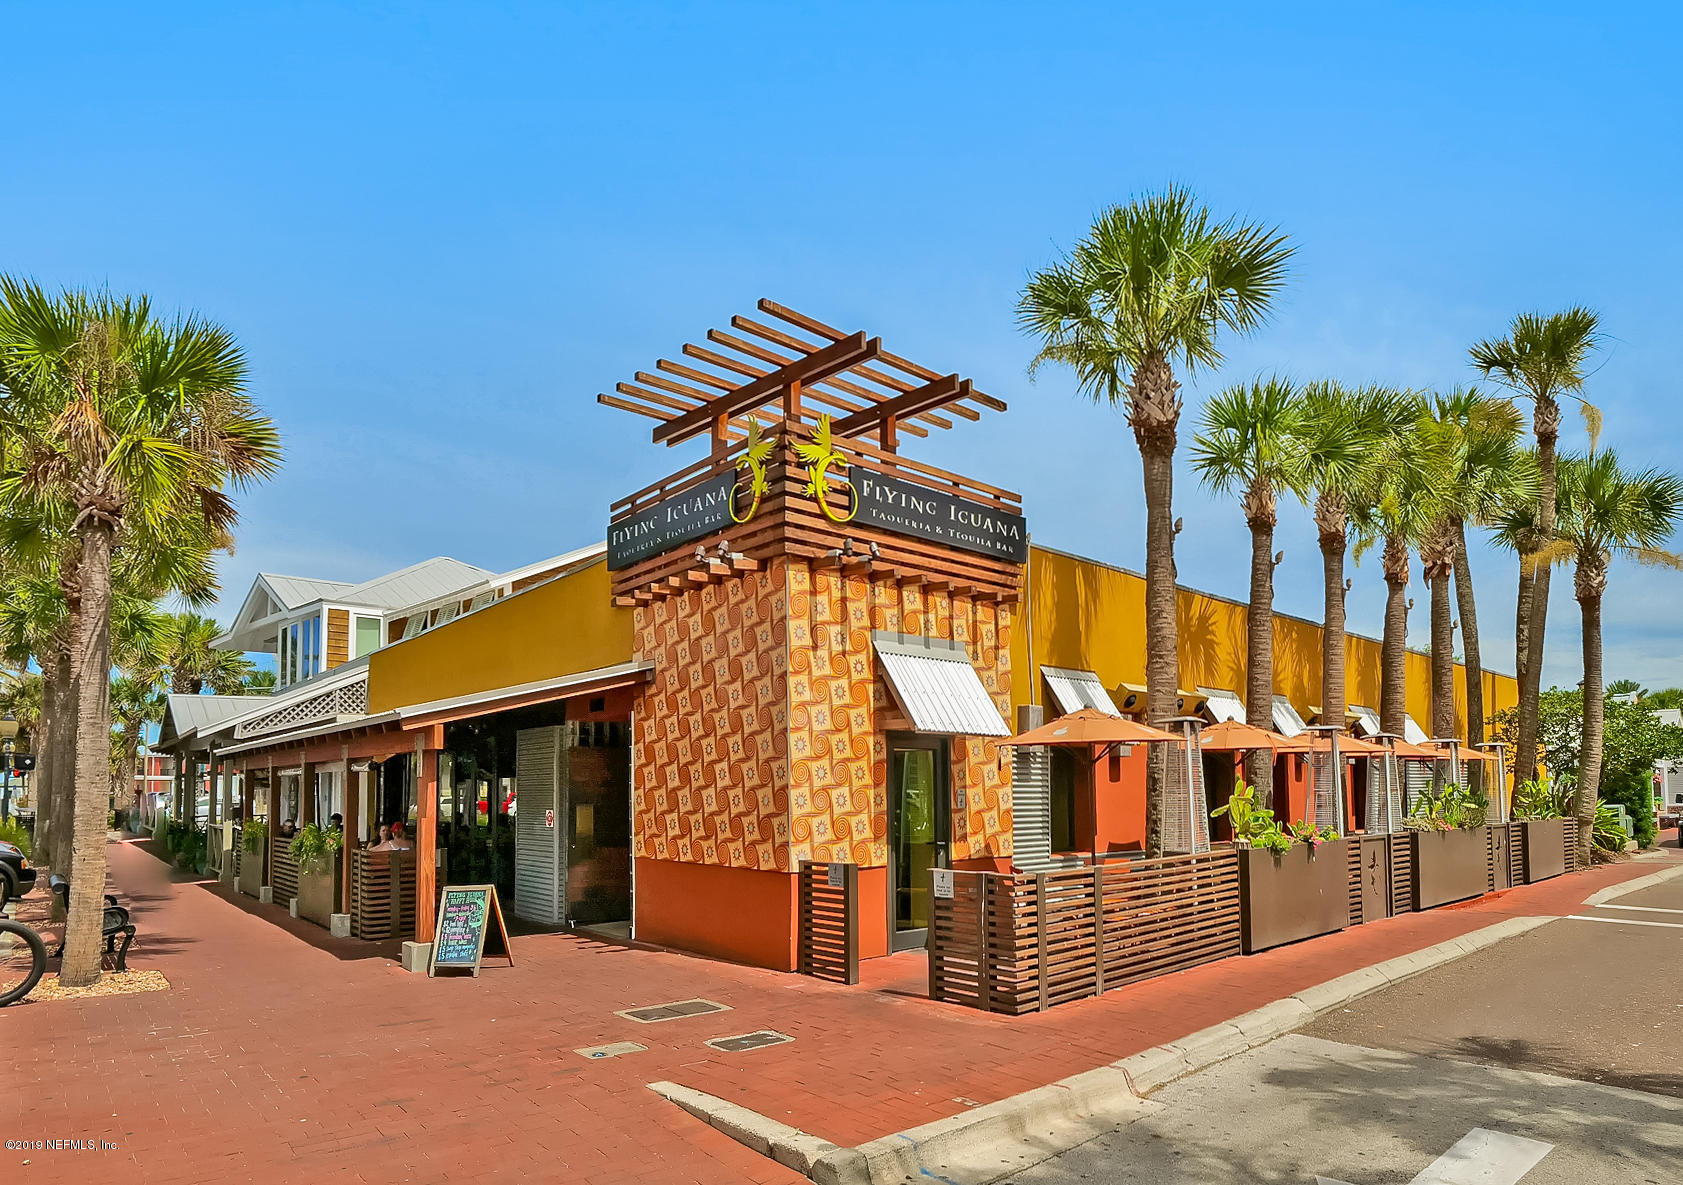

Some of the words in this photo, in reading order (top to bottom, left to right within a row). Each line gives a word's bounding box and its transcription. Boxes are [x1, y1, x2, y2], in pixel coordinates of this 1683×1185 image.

[612, 515, 659, 546] FLYING
[666, 486, 727, 523] IGUANA
[862, 479, 937, 515] FLYING
[949, 504, 1020, 540] IGUANA
[870, 508, 931, 533] TAQUERIA
[935, 526, 943, 534] &
[948, 528, 992, 548] TEQUILA
[996, 543, 1014, 553] BAR
